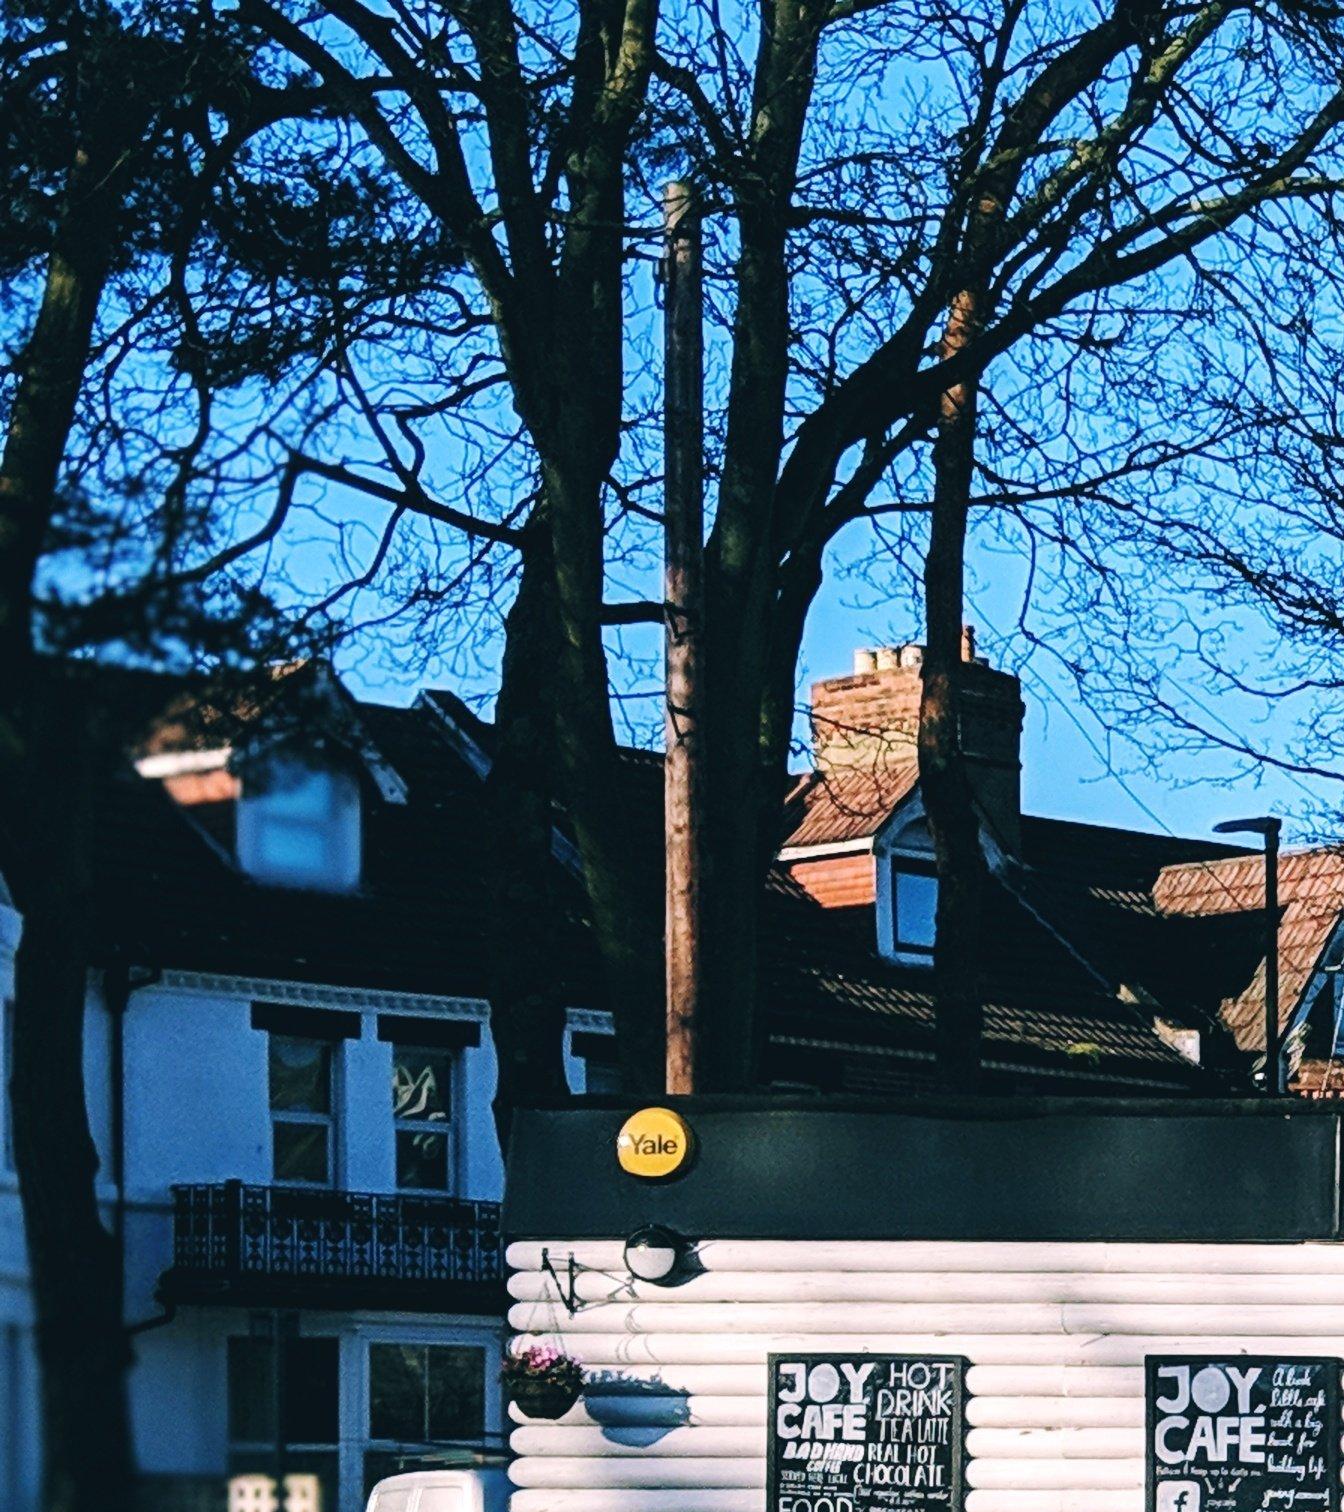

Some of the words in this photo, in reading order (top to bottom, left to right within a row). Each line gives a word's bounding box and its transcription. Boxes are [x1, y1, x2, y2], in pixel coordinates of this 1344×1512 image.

[628, 1133, 678, 1156] Yale
[777, 1362, 876, 1404] JOY
[889, 1361, 955, 1390] HOT
[1155, 1365, 1263, 1414] JOY
[875, 1389, 953, 1421] DRINK
[776, 1403, 867, 1441] CAFE
[879, 1417, 914, 1443] TEA
[868, 1442, 900, 1464] REAL
[906, 1444, 937, 1464] HOT
[852, 1462, 946, 1487] CHOCOLATE
